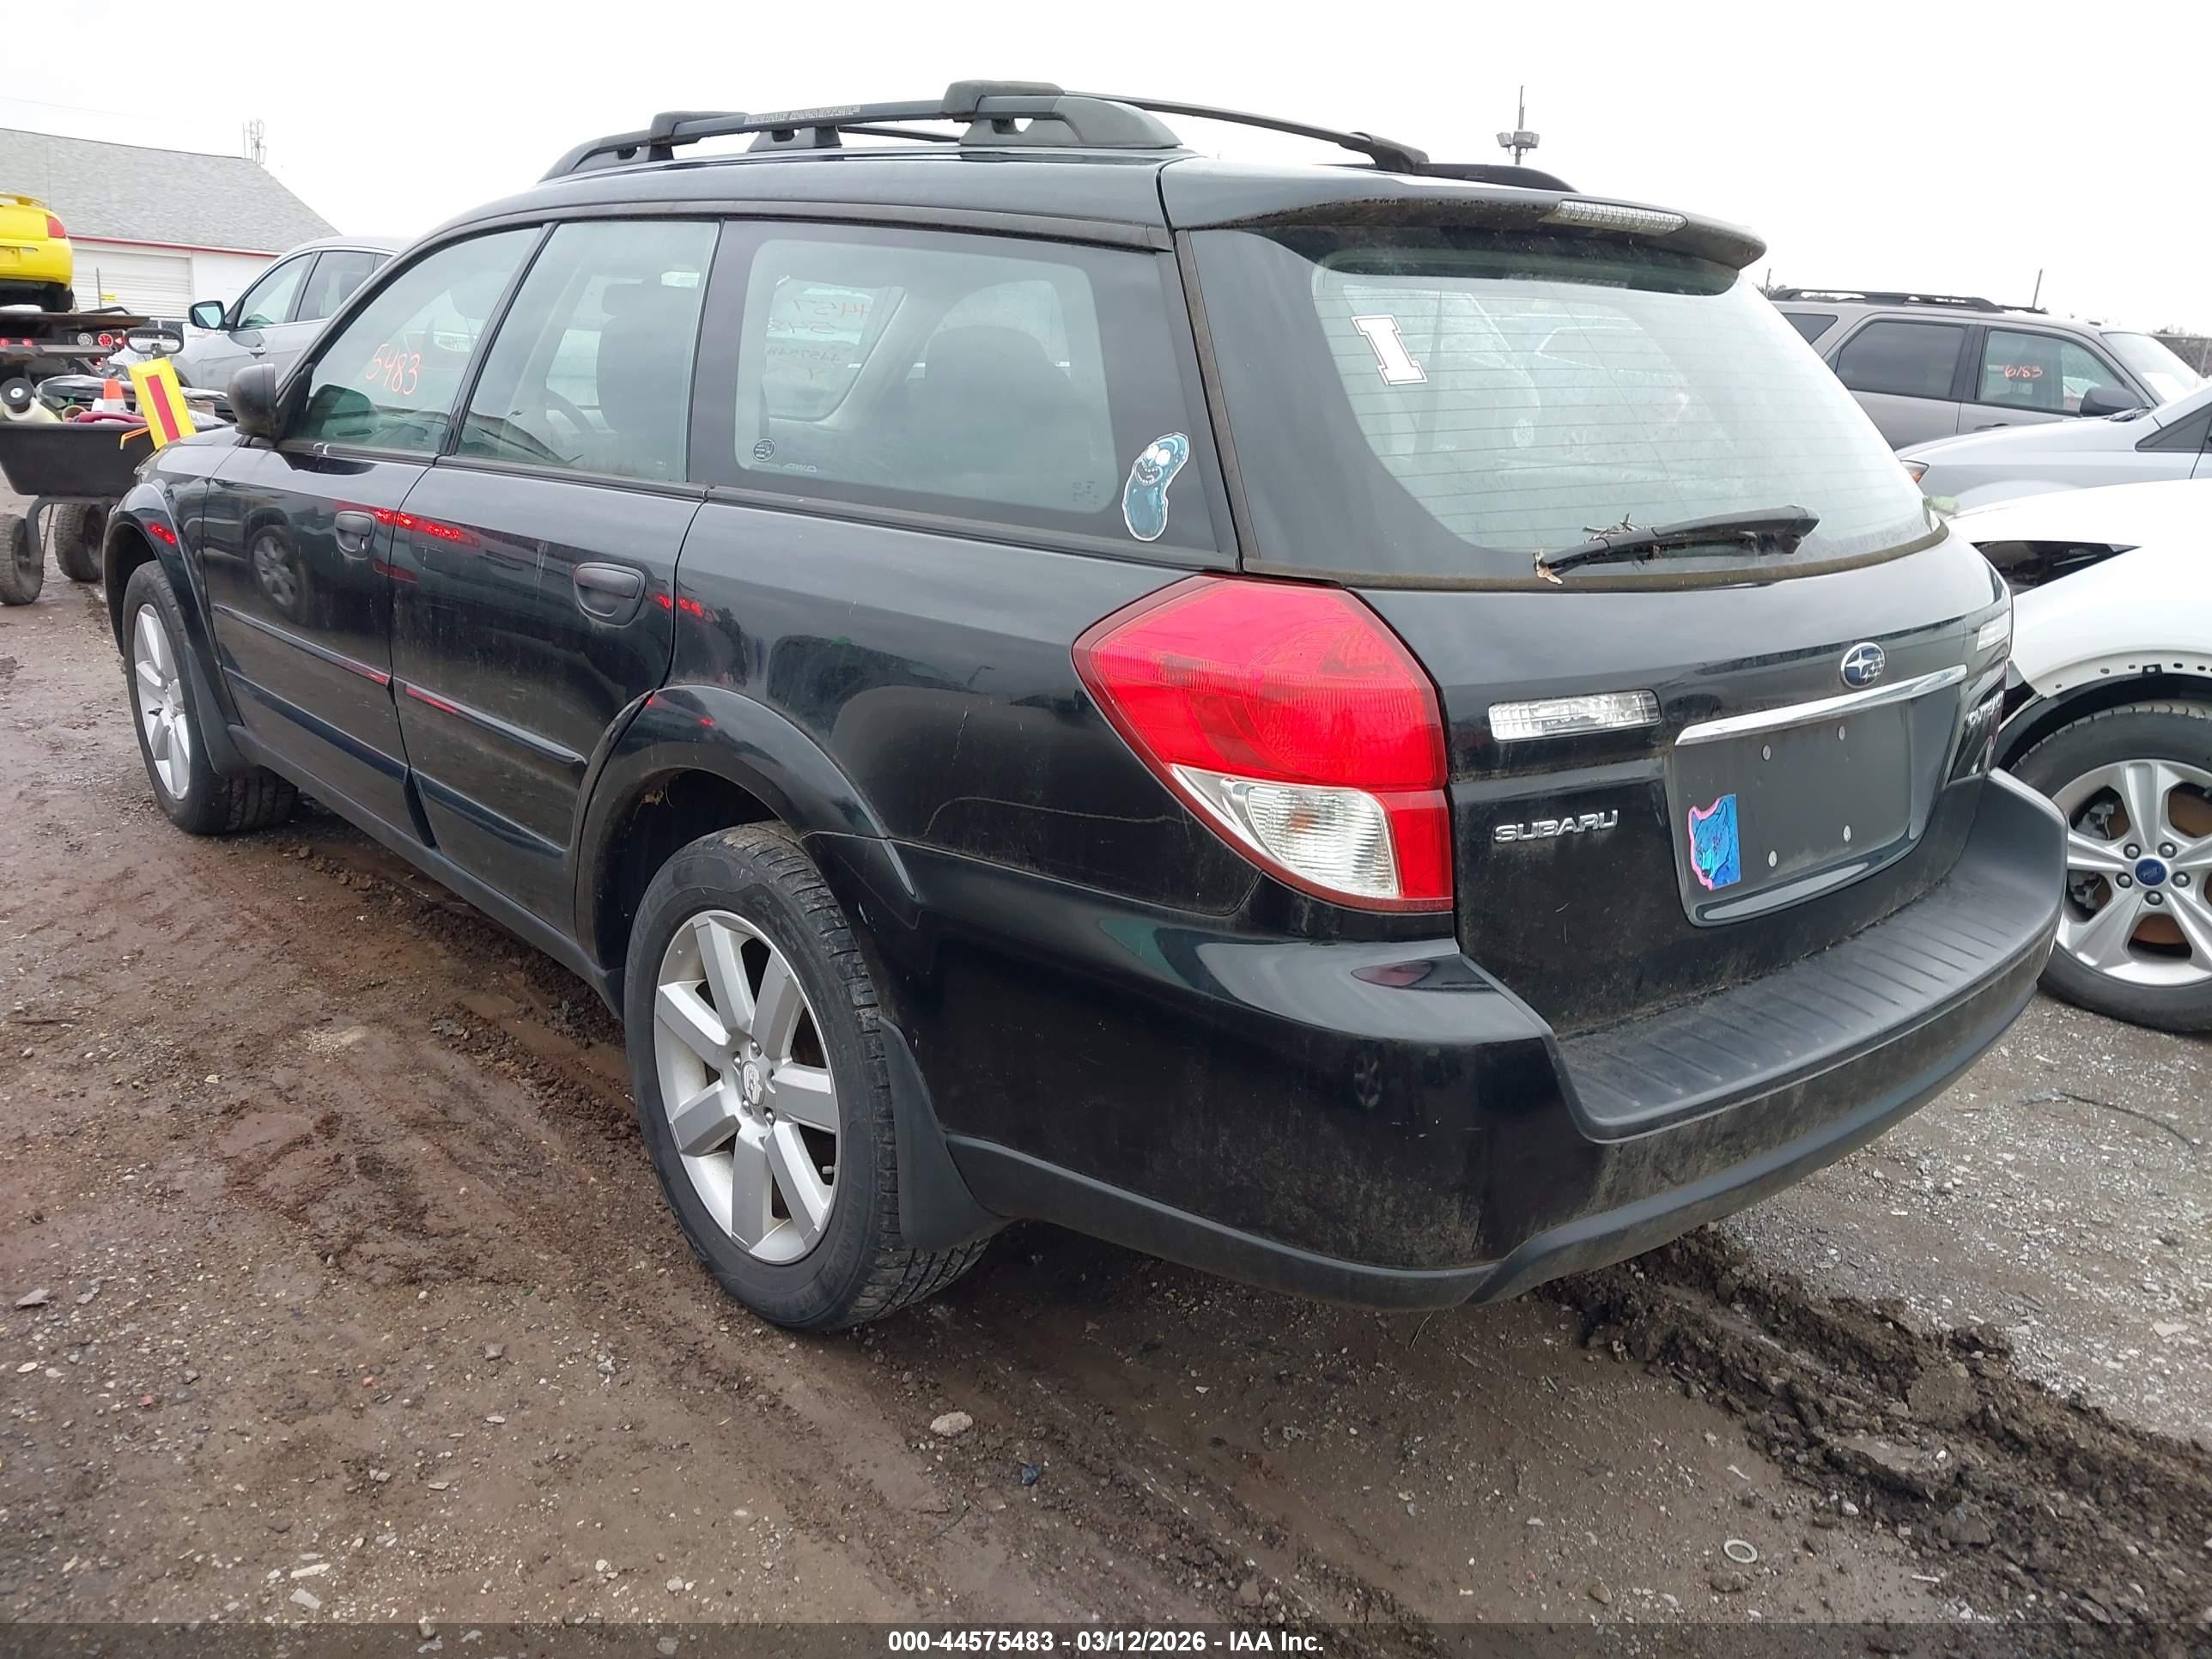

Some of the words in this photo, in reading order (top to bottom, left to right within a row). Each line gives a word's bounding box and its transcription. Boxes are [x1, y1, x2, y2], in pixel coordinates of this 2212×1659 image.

[366, 343, 421, 395] 5483
[2004, 364, 2044, 379] 6183
[1494, 810, 1619, 844] SUBARU
